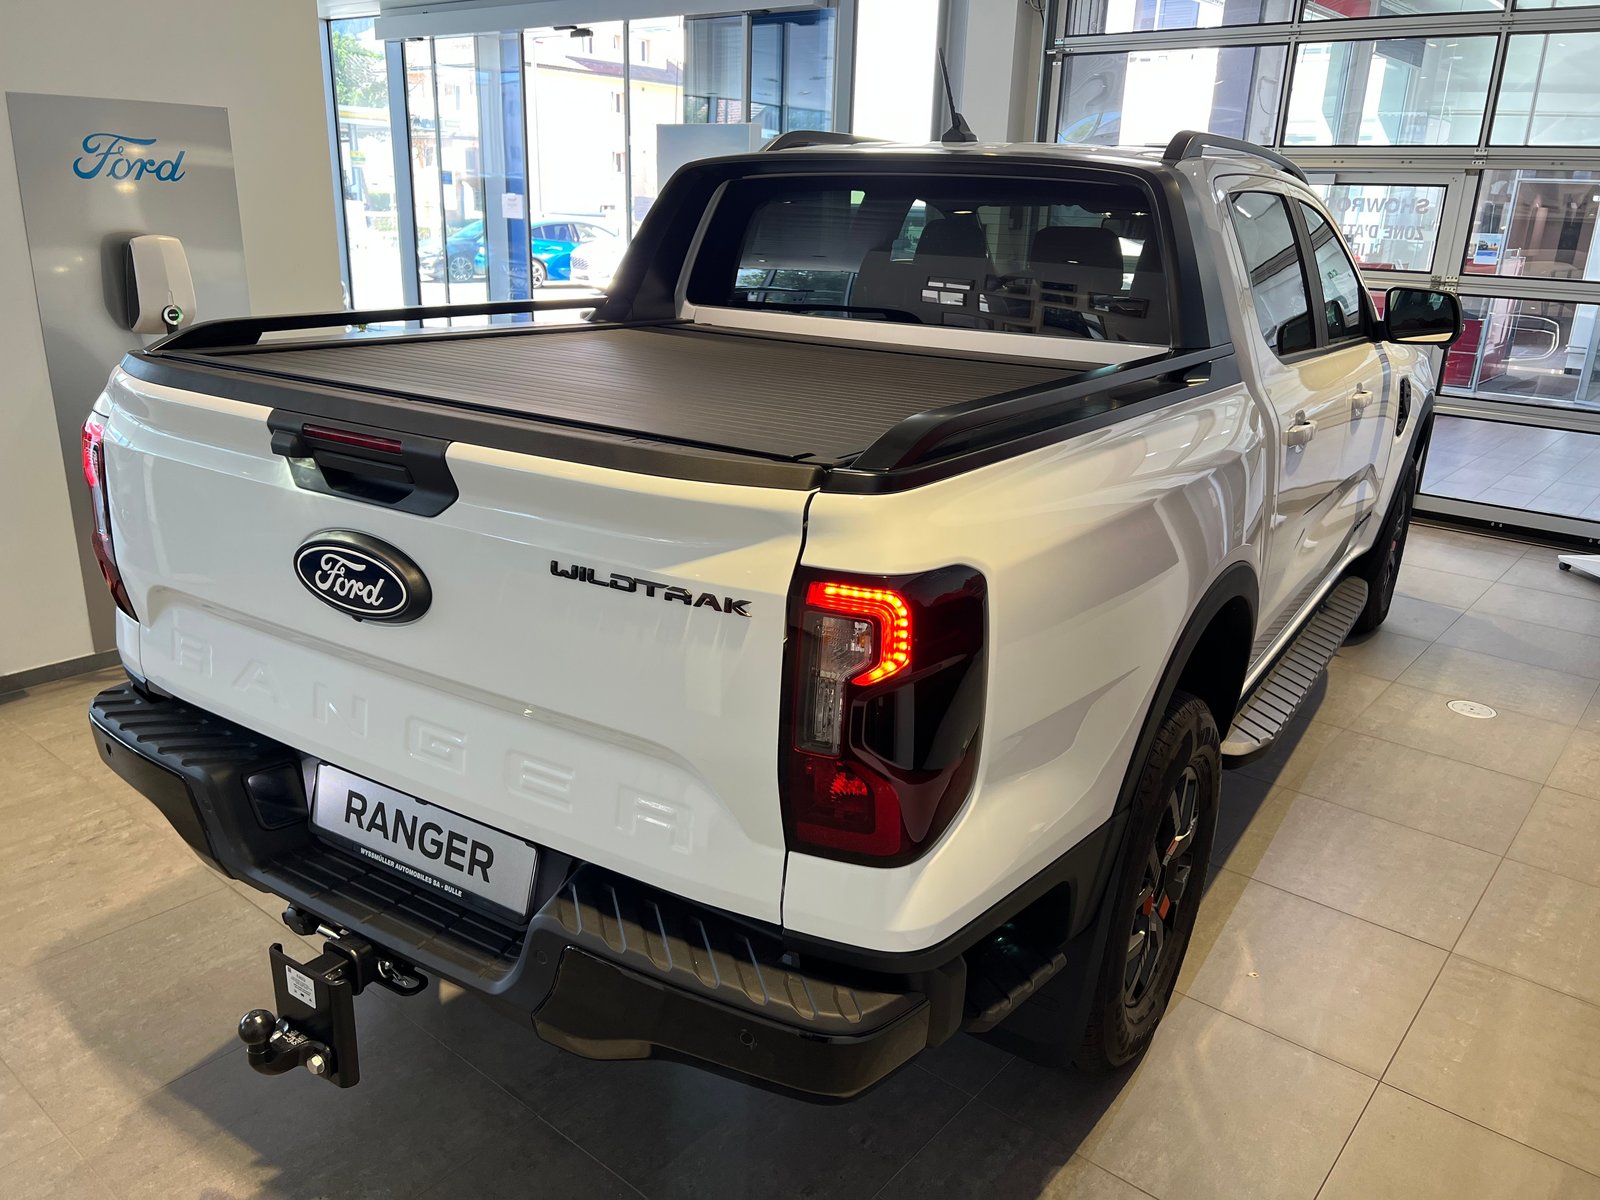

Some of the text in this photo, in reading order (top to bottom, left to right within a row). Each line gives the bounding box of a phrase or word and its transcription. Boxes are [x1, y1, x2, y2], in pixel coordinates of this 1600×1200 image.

[72, 132, 187, 182] Ford
[314, 553, 385, 607] Ford
[549, 559, 753, 618] WILDTRAK
[169, 627, 696, 856] RANGER
[344, 789, 495, 884] RANGER
[360, 847, 395, 868] WYSSMÜLLER
[394, 863, 432, 884] AUTOMOBILES
[432, 880, 441, 888] SA
[444, 884, 463, 898] BULLE
